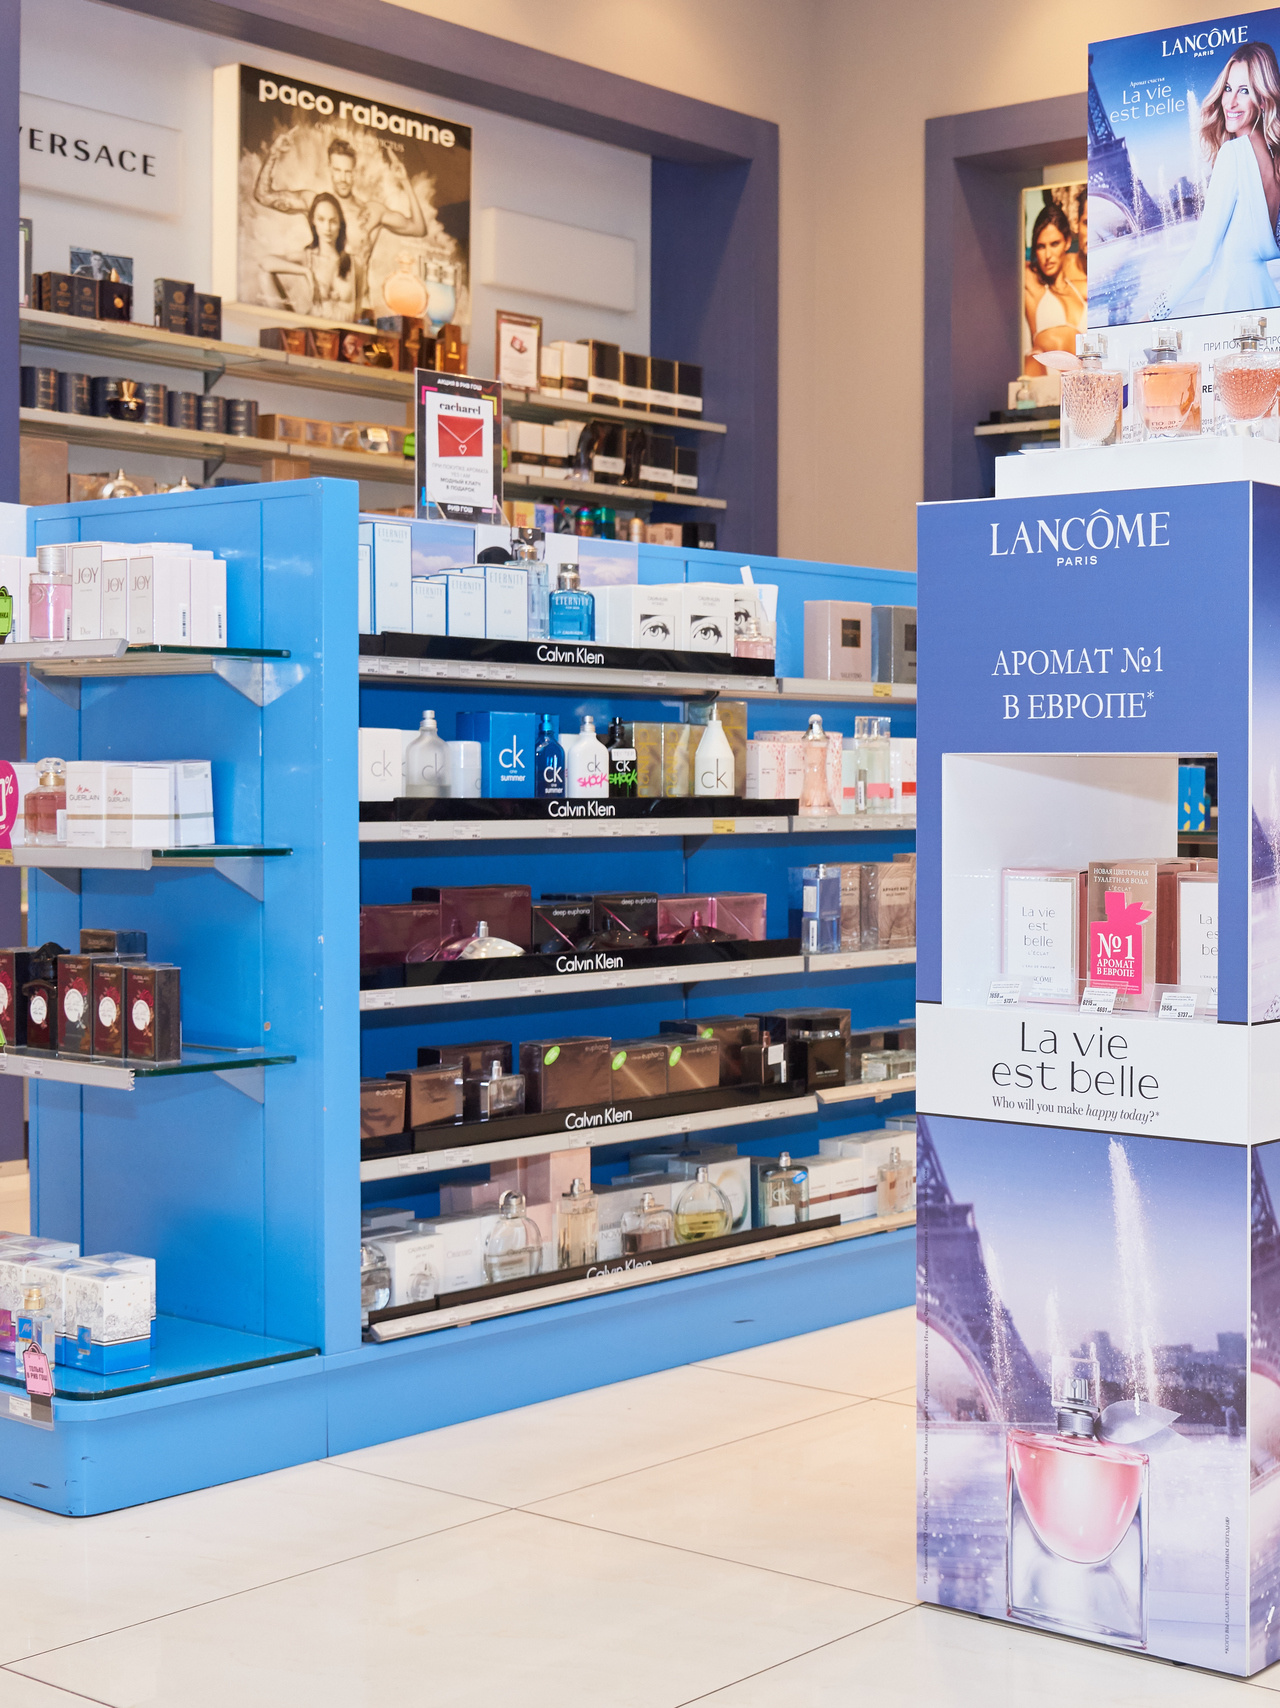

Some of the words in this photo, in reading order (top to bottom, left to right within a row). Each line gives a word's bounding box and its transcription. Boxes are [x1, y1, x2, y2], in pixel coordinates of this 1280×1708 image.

[1162, 25, 1248, 57] LANCÔME
[1193, 49, 1214, 58] PARIS
[1130, 79, 1146, 88] Аромат
[1147, 76, 1165, 84] счастья
[1123, 90, 1140, 105] La
[1147, 84, 1172, 100] vie
[259, 79, 333, 115] paco
[339, 100, 455, 148] rabanne
[1110, 108, 1141, 123] est
[1145, 98, 1185, 118] belle
[19, 126, 156, 177] ERSACE
[1204, 342, 1220, 351] ПРИ
[440, 402, 480, 414] cacharel
[378, 528, 408, 539] ETERNITY
[989, 508, 1170, 557] LANCÔME
[1056, 555, 1098, 567] PARIS
[75, 567, 99, 584] JOY
[132, 575, 151, 591] JOY
[490, 572, 524, 584] ETERNITY
[105, 577, 124, 593] JOY
[415, 586, 443, 596] ETERNITY
[451, 580, 481, 591] ETERNITY
[555, 596, 589, 607] ETERNITY
[80, 627, 91, 635] Dior
[536, 645, 575, 664] Calvin
[576, 648, 605, 665] Klein
[991, 647, 1113, 677] АРОМАТ
[1121, 645, 1164, 674] №1
[1002, 694, 1021, 720] В
[499, 735, 525, 769] ck
[371, 750, 392, 777] ck
[422, 753, 444, 782] ck
[543, 755, 563, 783] ck
[587, 754, 601, 772] ck
[577, 773, 608, 788] SHOCK
[609, 769, 637, 788] SHOCK
[701, 758, 728, 788] ck
[548, 800, 586, 817] Calvin
[587, 801, 615, 816] Klein
[1113, 868, 1149, 876] ЦВЕТОЧНАЯ
[621, 898, 635, 906] deep
[636, 897, 657, 905] euphoria
[1022, 907, 1034, 917] La
[1039, 908, 1055, 918] vie
[1200, 914, 1212, 924] La
[1028, 922, 1048, 931] est
[1024, 935, 1053, 947] belle
[556, 955, 594, 973] Calvin
[595, 953, 624, 969] Klein
[1097, 959, 1135, 969] АРОМАТ
[1097, 967, 1102, 975] В
[1103, 968, 1135, 977] ЕВРОПЕ
[1021, 1022, 1058, 1054] La
[1073, 1026, 1128, 1059] vie
[992, 1062, 1057, 1090] est
[1071, 1061, 1159, 1100] belle
[992, 1095, 1015, 1109] Who
[1017, 1099, 1034, 1111] will
[1036, 1103, 1055, 1114] you
[1057, 1102, 1084, 1115] make
[1086, 1105, 1118, 1121] happy
[565, 1112, 602, 1130] Calvin
[605, 1107, 633, 1124] Klein
[601, 1231, 621, 1241] NOW
[922, 1457, 930, 1476] Trends
[922, 1533, 930, 1547] NPD
[1224, 1624, 1230, 1633] ВЫ
